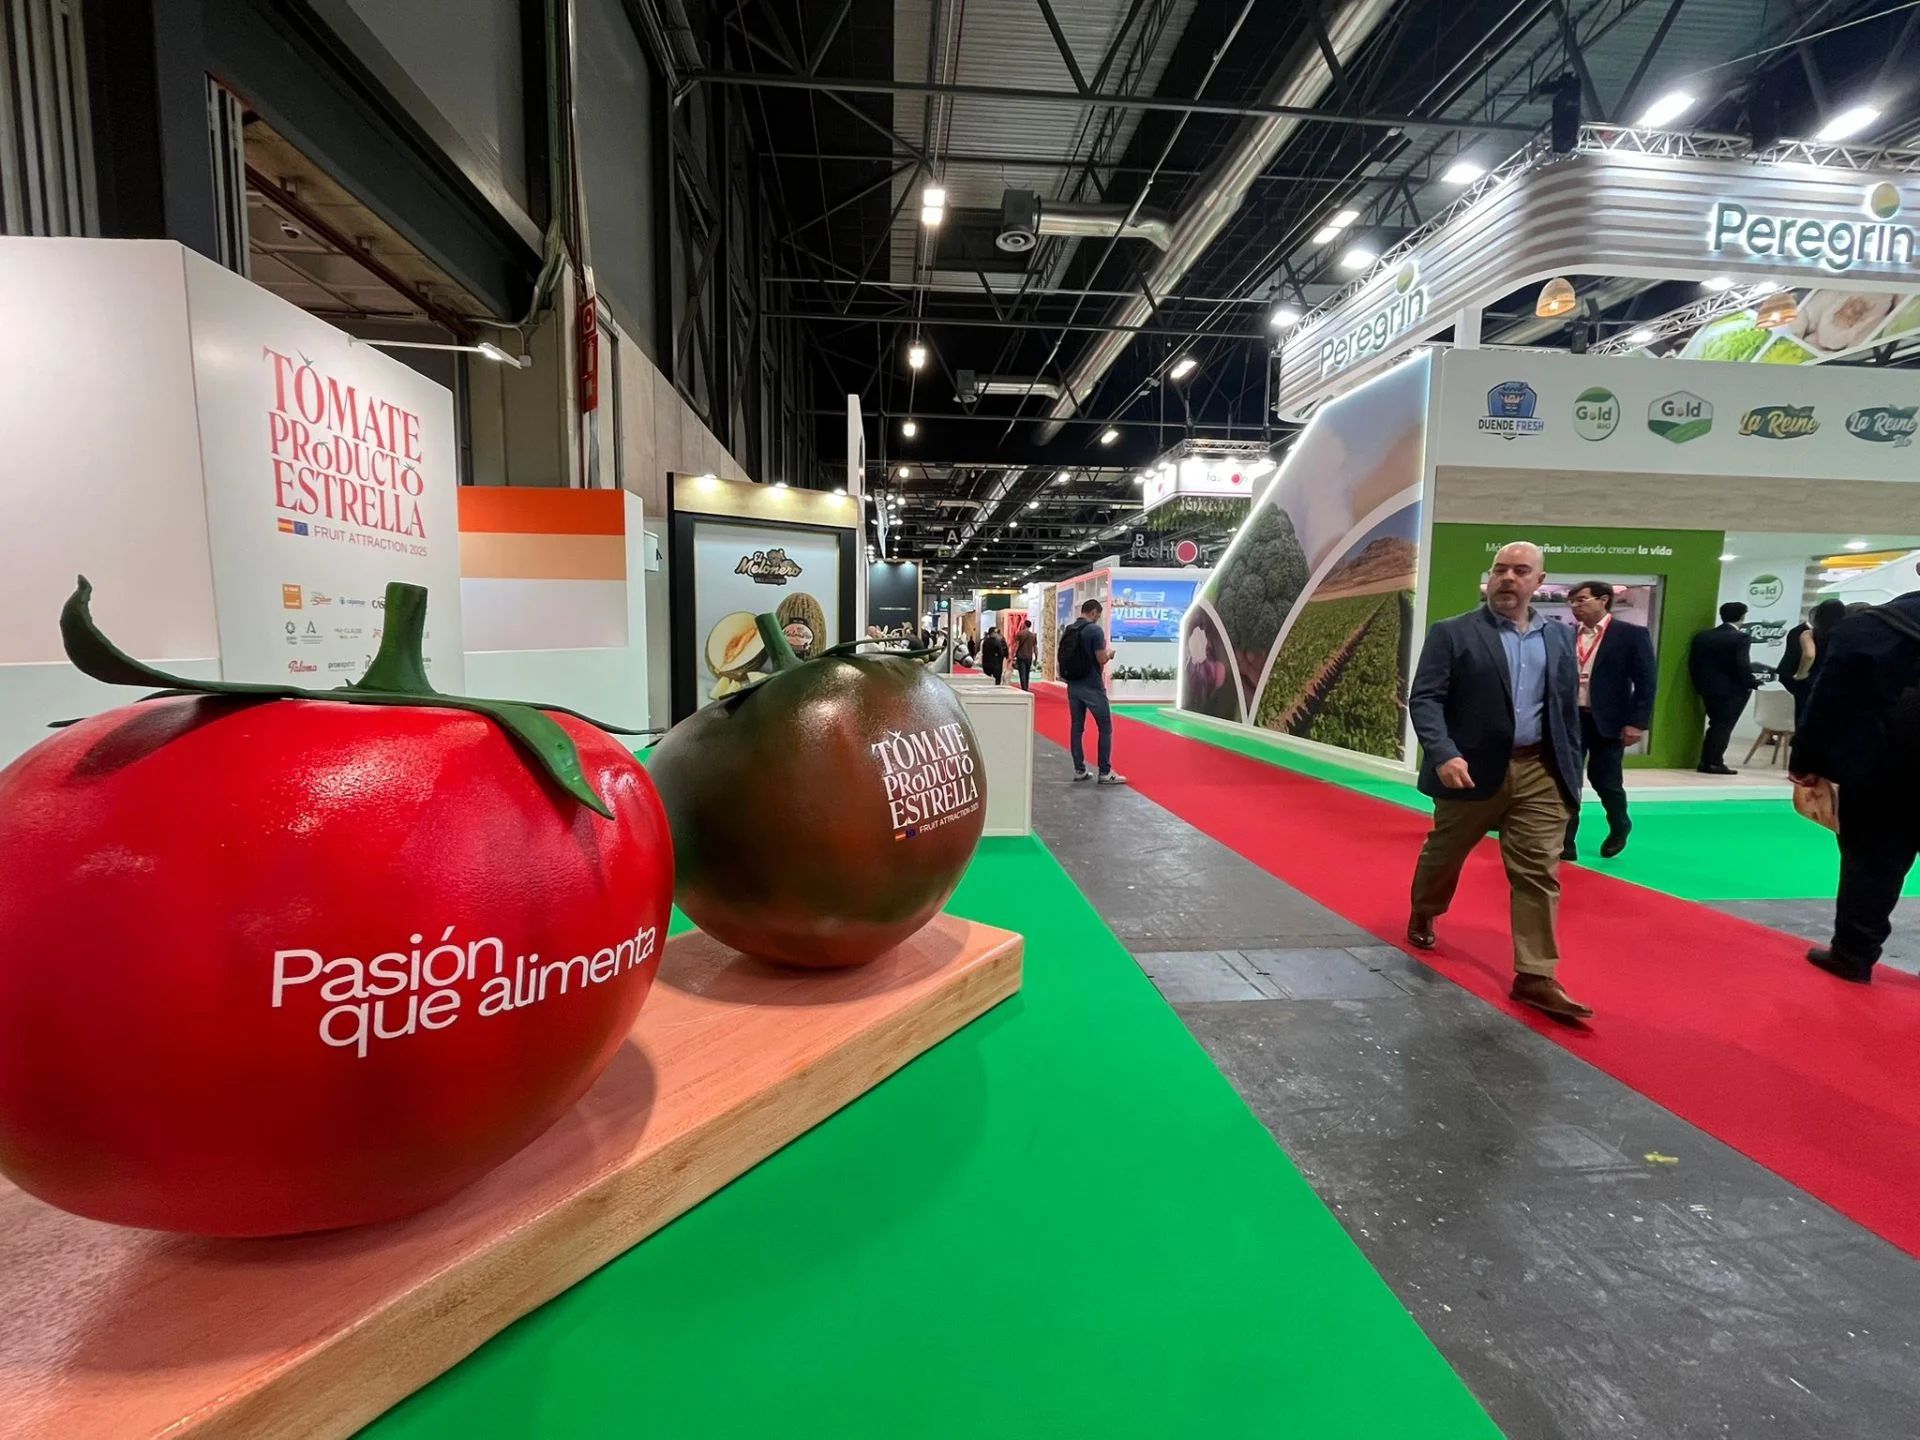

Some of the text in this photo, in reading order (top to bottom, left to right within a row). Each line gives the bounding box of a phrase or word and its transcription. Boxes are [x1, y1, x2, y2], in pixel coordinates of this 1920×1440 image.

[1713, 201, 1915, 271] Peregrin
[1319, 278, 1429, 378] Peregrin
[263, 345, 422, 464] TOMATE
[1576, 406, 1612, 421] Gold
[1661, 401, 1702, 417] Gold
[1478, 419, 1544, 432] DUENDE FRESH
[1738, 410, 1821, 437] La Reine
[1849, 411, 1918, 436] La Reine
[268, 411, 424, 496] PRODUCTO
[272, 458, 427, 539] ESTRELLA
[313, 525, 346, 542] FRUIT
[349, 533, 408, 553] ATTRACTION
[946, 530, 959, 543] A
[1135, 533, 1145, 547] B
[1563, 543, 1606, 555] haciendo
[1608, 547, 1635, 555] crecer
[1638, 545, 1649, 555] la
[1650, 546, 1673, 556] vida
[736, 557, 800, 576] Melonero
[1115, 607, 1169, 621] VUELVE
[871, 723, 969, 775] TOMATE
[883, 754, 974, 801] PRODUCTO
[889, 775, 979, 830] ESTRELLA
[919, 822, 939, 834] FRUIT
[939, 808, 971, 826] ATTRACTION
[271, 925, 504, 1008] Pasión
[319, 925, 657, 1058] que alimenta
